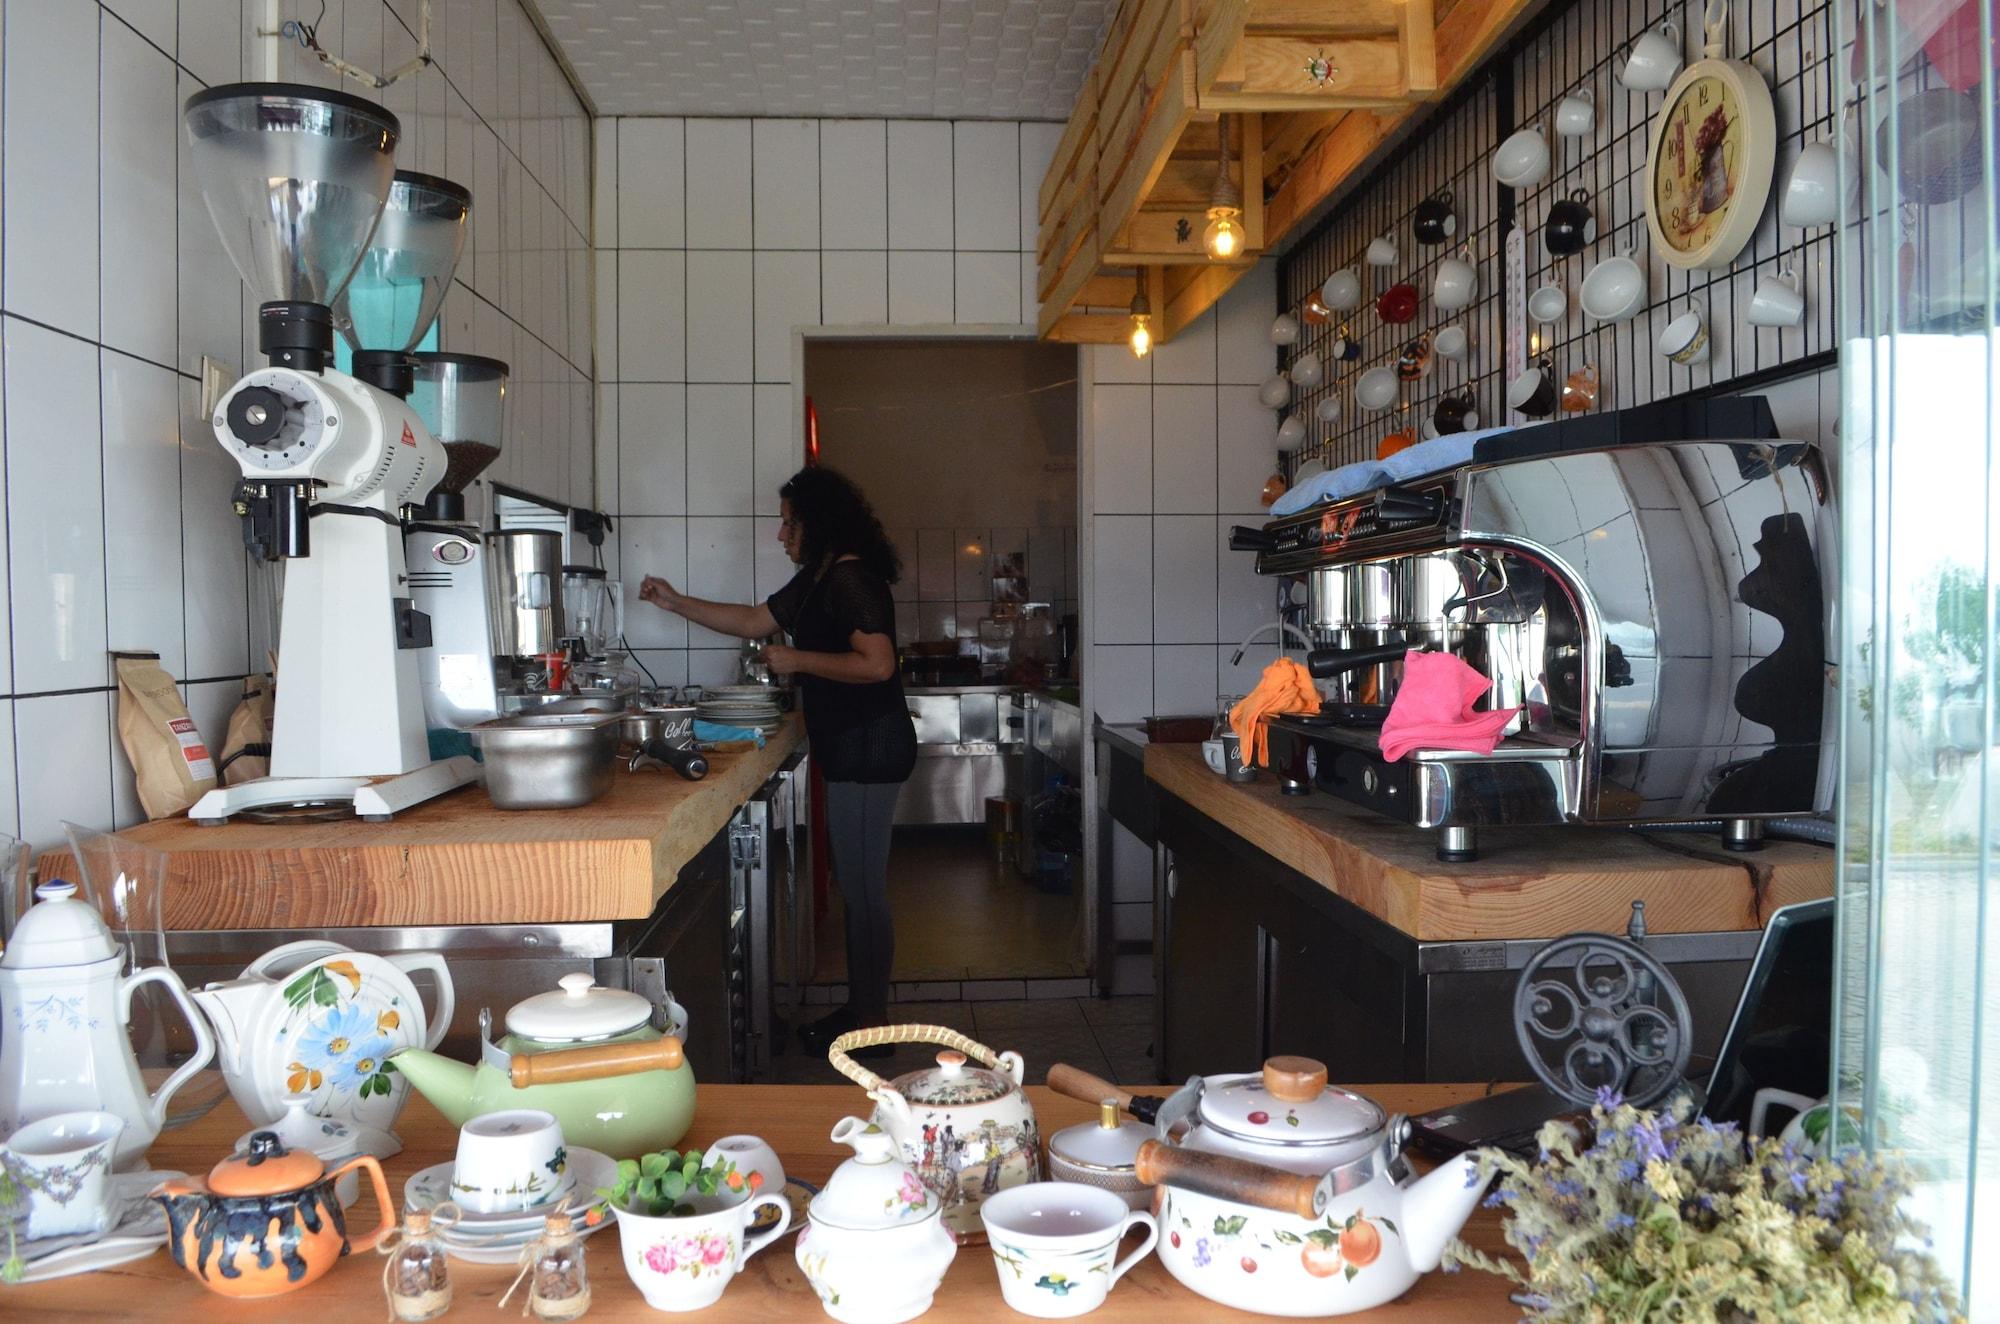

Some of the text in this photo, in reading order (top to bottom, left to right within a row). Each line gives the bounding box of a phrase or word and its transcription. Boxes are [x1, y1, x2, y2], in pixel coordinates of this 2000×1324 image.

[1699, 84, 1709, 107] 12
[1683, 102, 1691, 126] 11
[1667, 139, 1678, 161] 10
[1664, 178, 1673, 201] 9
[1671, 207, 1681, 230] 8
